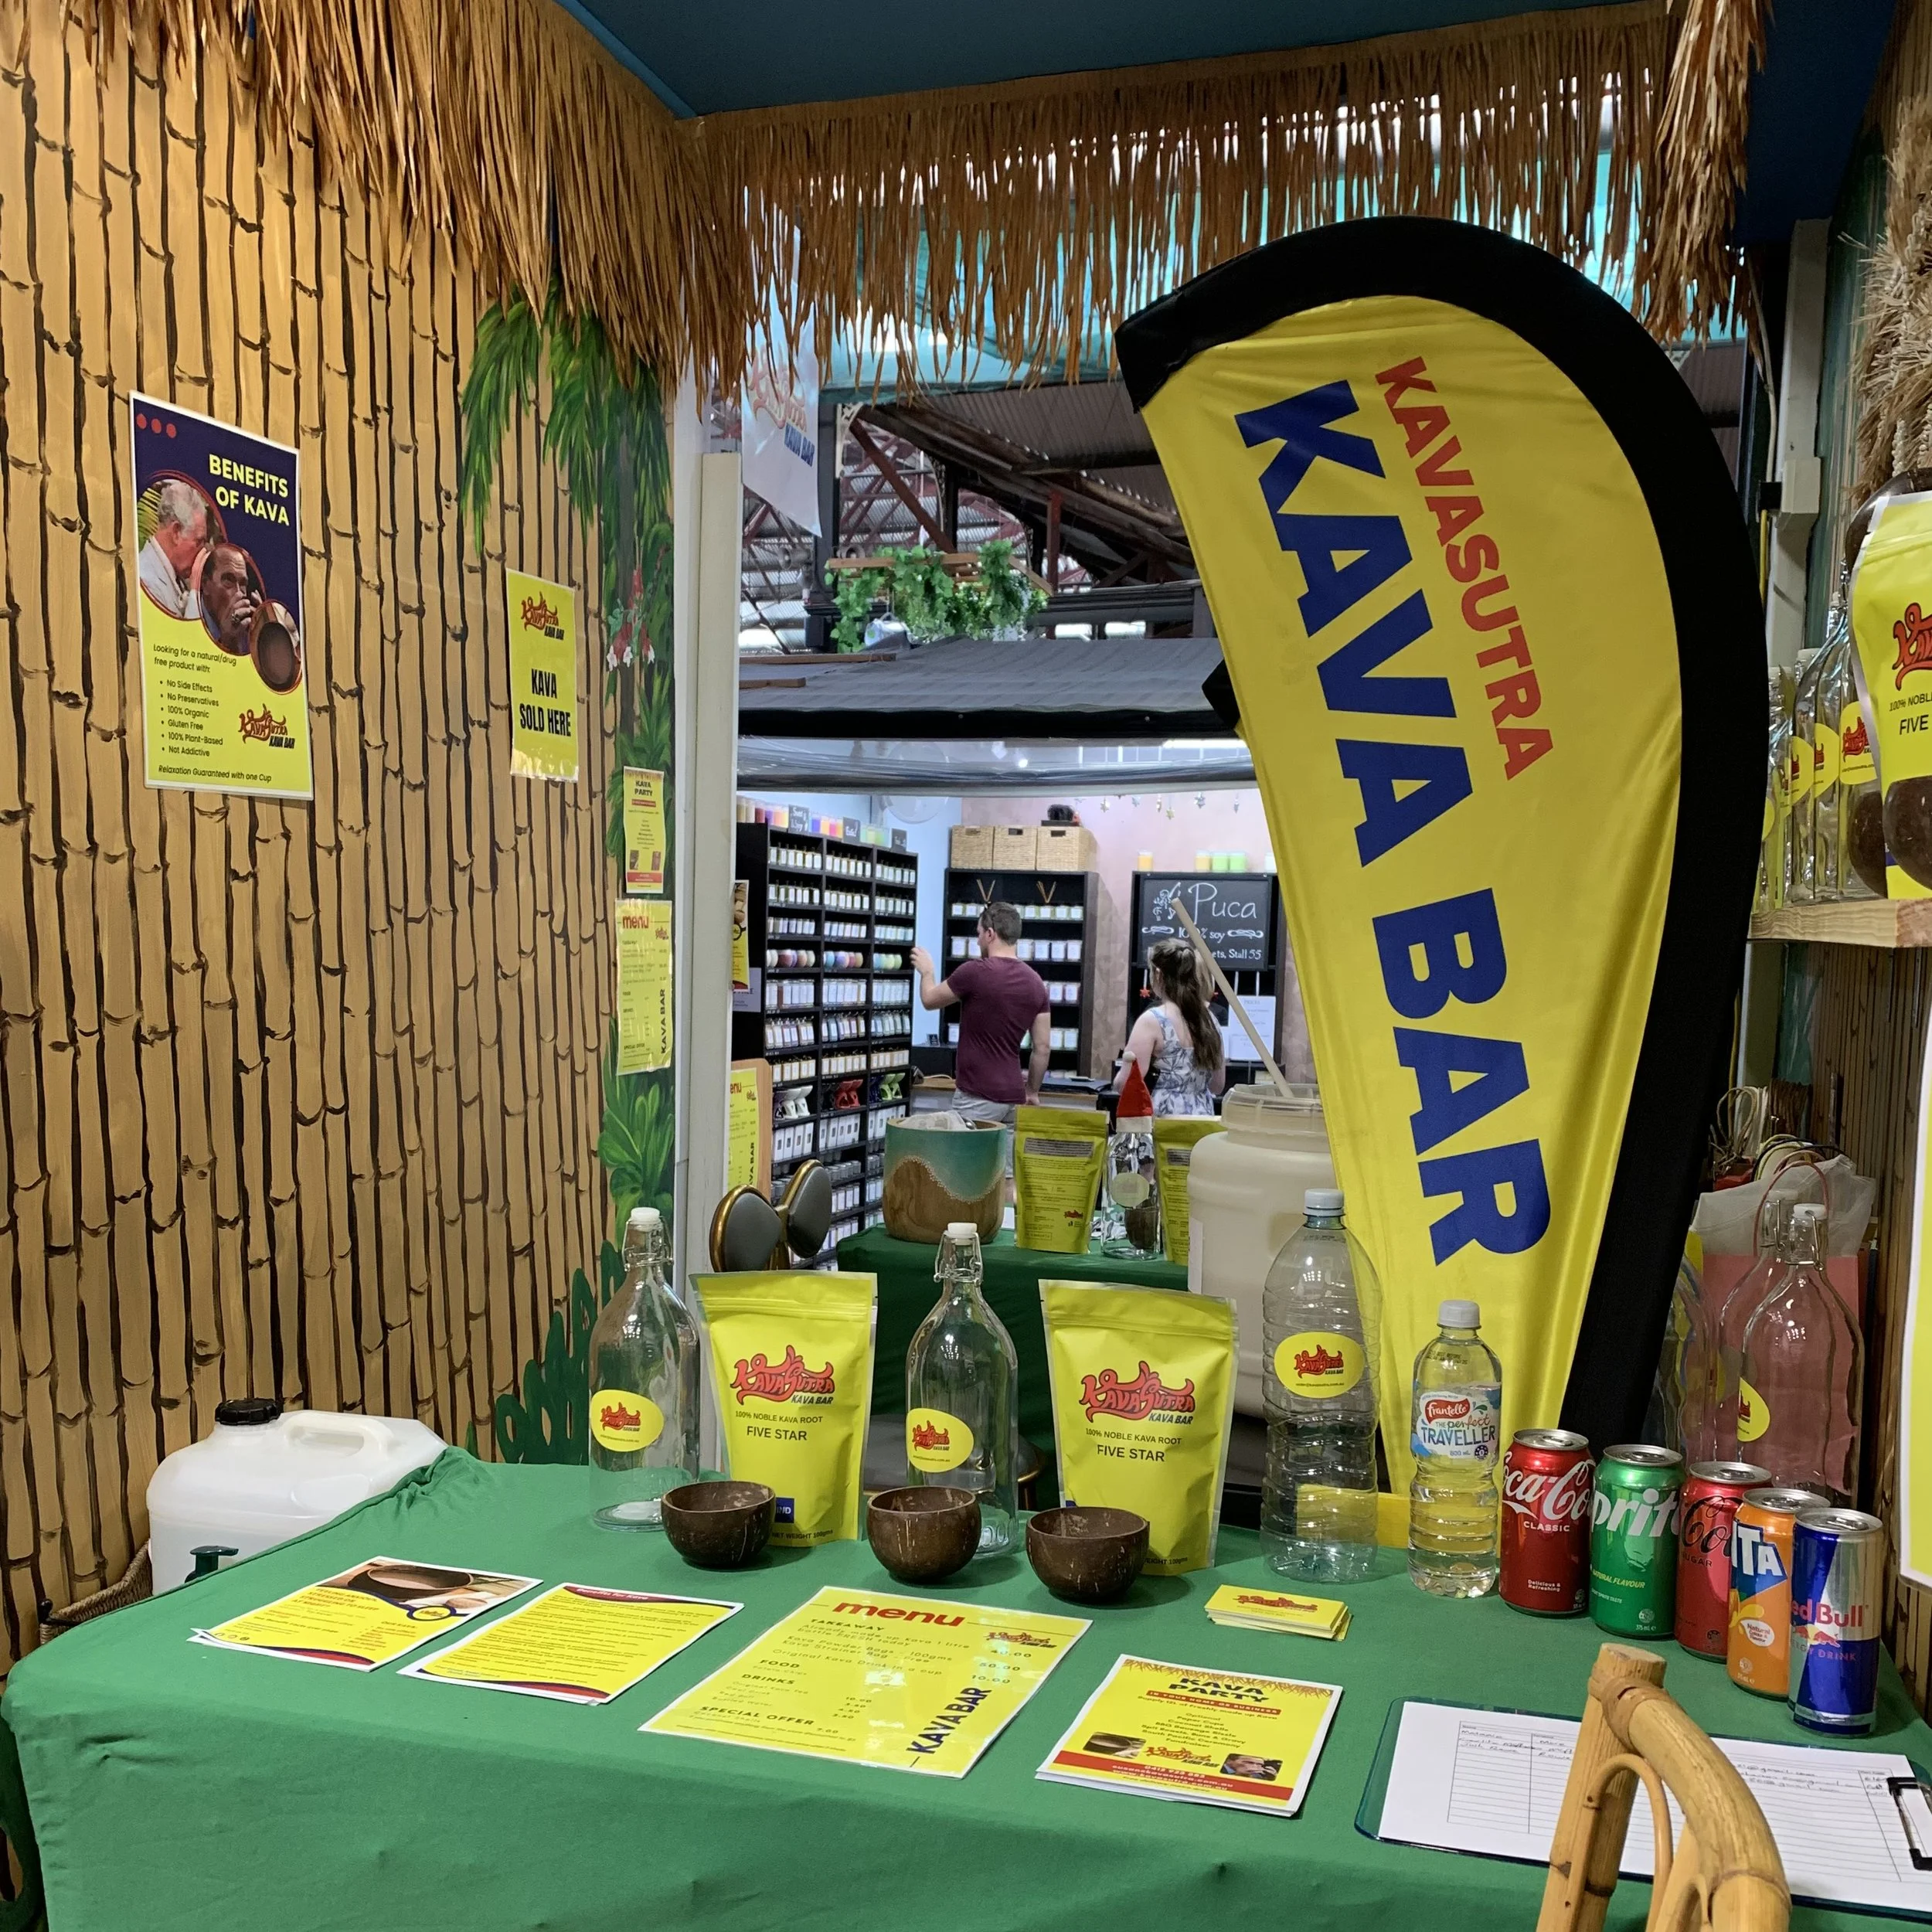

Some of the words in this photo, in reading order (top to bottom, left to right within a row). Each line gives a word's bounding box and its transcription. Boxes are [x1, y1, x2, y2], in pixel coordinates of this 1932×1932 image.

[784, 423, 801, 457] KAVA
[801, 437, 815, 467] BAR
[209, 454, 288, 498] BENEFITS
[216, 486, 239, 509] OF
[244, 495, 290, 526] KAVA
[1375, 355, 1553, 781] KAVASUTRA
[154, 644, 179, 657] Looking
[180, 648, 190, 657] for
[196, 651, 236, 666] natural/drug
[155, 657, 167, 666] free
[168, 660, 195, 671] product
[167, 679, 176, 688] No
[177, 681, 191, 690] Side
[192, 682, 213, 692] Effects
[531, 668, 557, 699] KAVA
[168, 692, 176, 701] No
[178, 694, 219, 706] Preservatives
[1889, 699, 1906, 712] 100%
[168, 706, 183, 715] 100%
[185, 708, 209, 719] Organic
[519, 703, 544, 732] SOLD
[547, 709, 571, 736] HERE
[168, 719, 189, 730] Gluten
[190, 722, 203, 730] Free
[1900, 714, 1930, 735] FIVE
[168, 733, 184, 742] 100%
[185, 734, 223, 745] Plant-Based
[269, 736, 284, 747] KAVA
[284, 737, 295, 750] BAR
[168, 746, 180, 754] Not
[181, 747, 209, 757] Addictive
[158, 765, 191, 776] Relaxation
[193, 768, 230, 779] Guaranteed
[231, 770, 244, 780] with
[259, 774, 271, 784] Cup
[634, 788, 653, 797] PARTY
[1233, 379, 1473, 868] KAVA
[1372, 887, 1551, 1267] BAR
[1188, 883, 1257, 925] Puca
[623, 915, 648, 929] menu
[1179, 927, 1208, 939] 10%
[1209, 930, 1226, 944] soy
[1229, 949, 1247, 959] Stall
[1248, 950, 1262, 960] 55
[730, 1082, 742, 1094] enu
[791, 1394, 814, 1404] KAVA
[815, 1395, 833, 1404] BAR
[736, 1410, 752, 1420] 100%
[753, 1413, 777, 1422] NOBLE
[779, 1415, 798, 1423] KAVA
[1427, 1402, 1467, 1417] frantelle
[1148, 1413, 1173, 1423] KAVA
[1174, 1414, 1193, 1425] BAR
[1447, 1414, 1491, 1430] perfect
[747, 1426, 771, 1438] FIVE
[774, 1429, 807, 1441] STAR
[1086, 1427, 1102, 1437] 100%
[1104, 1430, 1132, 1441] NOBLE
[1134, 1434, 1157, 1443] KAVA
[1158, 1436, 1182, 1445] ROOT
[1421, 1425, 1495, 1446] TRAVELLER
[1097, 1444, 1125, 1458] FIVE
[1129, 1447, 1165, 1462] STAR
[1592, 1488, 1679, 1537] prit
[1523, 1521, 1570, 1532] CLASSIC
[1613, 1577, 1645, 1588] FLAVOUR
[832, 1602, 965, 1627] menu
[1791, 1598, 1813, 1621] ed
[1816, 1602, 1863, 1628] Bull
[811, 1619, 884, 1631] TAKEAWAY
[1747, 1623, 1770, 1634] Natural
[815, 1645, 862, 1654] Strainer
[819, 1640, 862, 1648] Powder
[910, 1651, 953, 1661] 100gms
[1818, 1648, 1855, 1661] DRINK
[760, 1659, 800, 1668] FOOD
[772, 1648, 821, 1659] Original
[858, 1660, 888, 1668] Drink
[742, 1674, 795, 1685] DRINKS
[972, 1675, 1010, 1683] 10.00
[1168, 1683, 1269, 1702] PARTY
[1180, 1678, 1264, 1695] KAVA
[1138, 1696, 1164, 1704] Supply
[1233, 1704, 1277, 1713] BUSINESS
[700, 1706, 760, 1718] SPECIAL
[767, 1714, 815, 1726] OFFER
[906, 1715, 968, 1753] KAVA
[944, 1687, 992, 1713] BAR
[1168, 1719, 1202, 1727] Coconut
[1185, 1712, 1221, 1721] Optional
[1174, 1724, 1210, 1733] Sausage
[1166, 1737, 1210, 1747] Fundraiser
[1198, 1738, 1240, 1748] Ceremony
